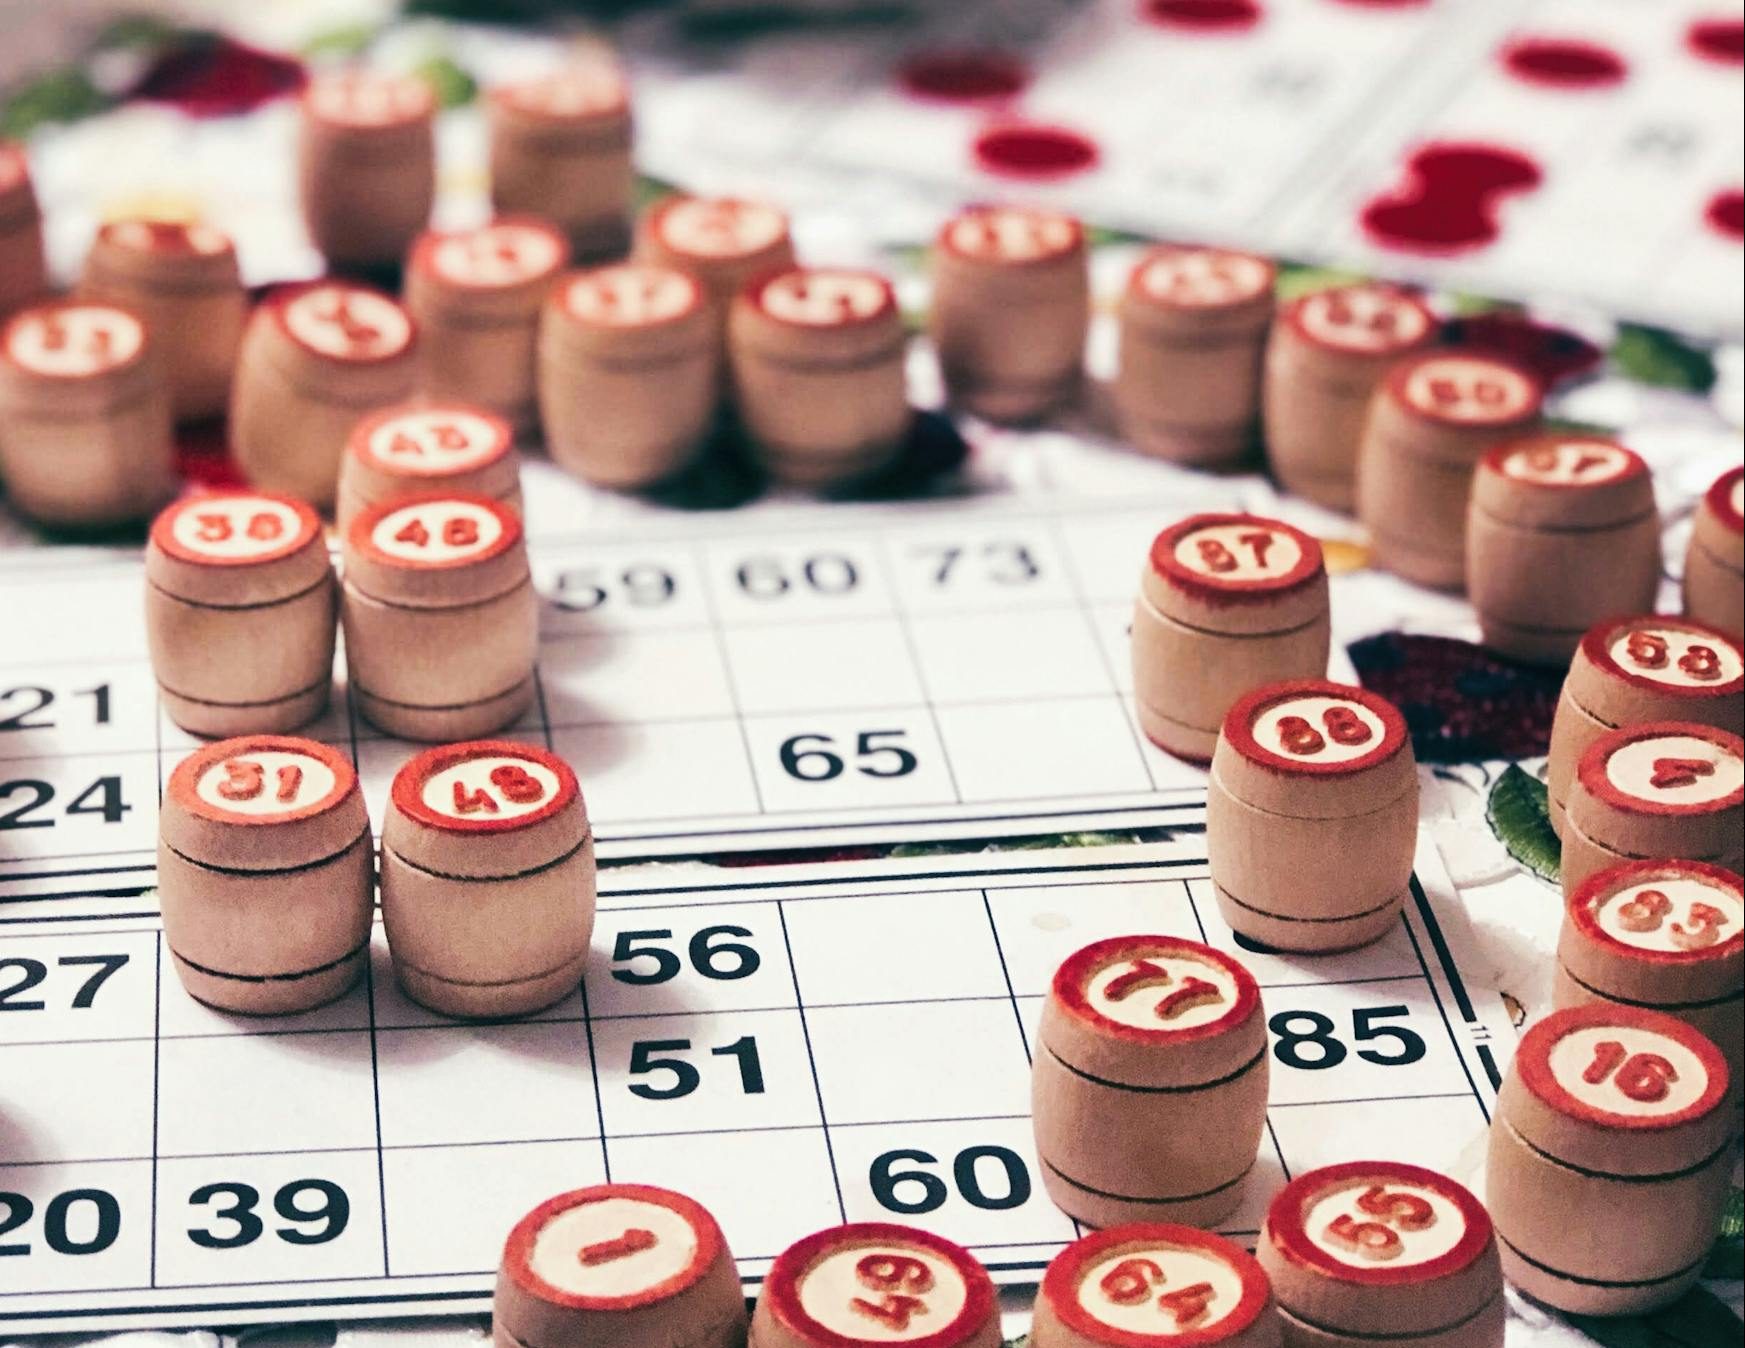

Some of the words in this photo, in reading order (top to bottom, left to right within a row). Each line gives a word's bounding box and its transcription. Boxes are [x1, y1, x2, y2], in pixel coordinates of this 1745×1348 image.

[553, 563, 676, 612] 59
[735, 552, 859, 600] 60
[0, 684, 110, 733] 21
[1276, 705, 1374, 757] 88
[215, 759, 303, 804] 31
[779, 730, 918, 782] 65
[0, 776, 132, 831] 24
[1617, 889, 1730, 949] 83
[0, 954, 130, 1011] 27
[610, 925, 761, 986] 56
[1267, 1004, 1427, 1070] 85
[628, 1036, 765, 1100] 51
[1581, 1040, 1681, 1104] 16
[869, 1145, 1031, 1214] 60
[187, 1179, 350, 1249] 39
[577, 1228, 659, 1268] 1
[1099, 1258, 1219, 1331] 64
